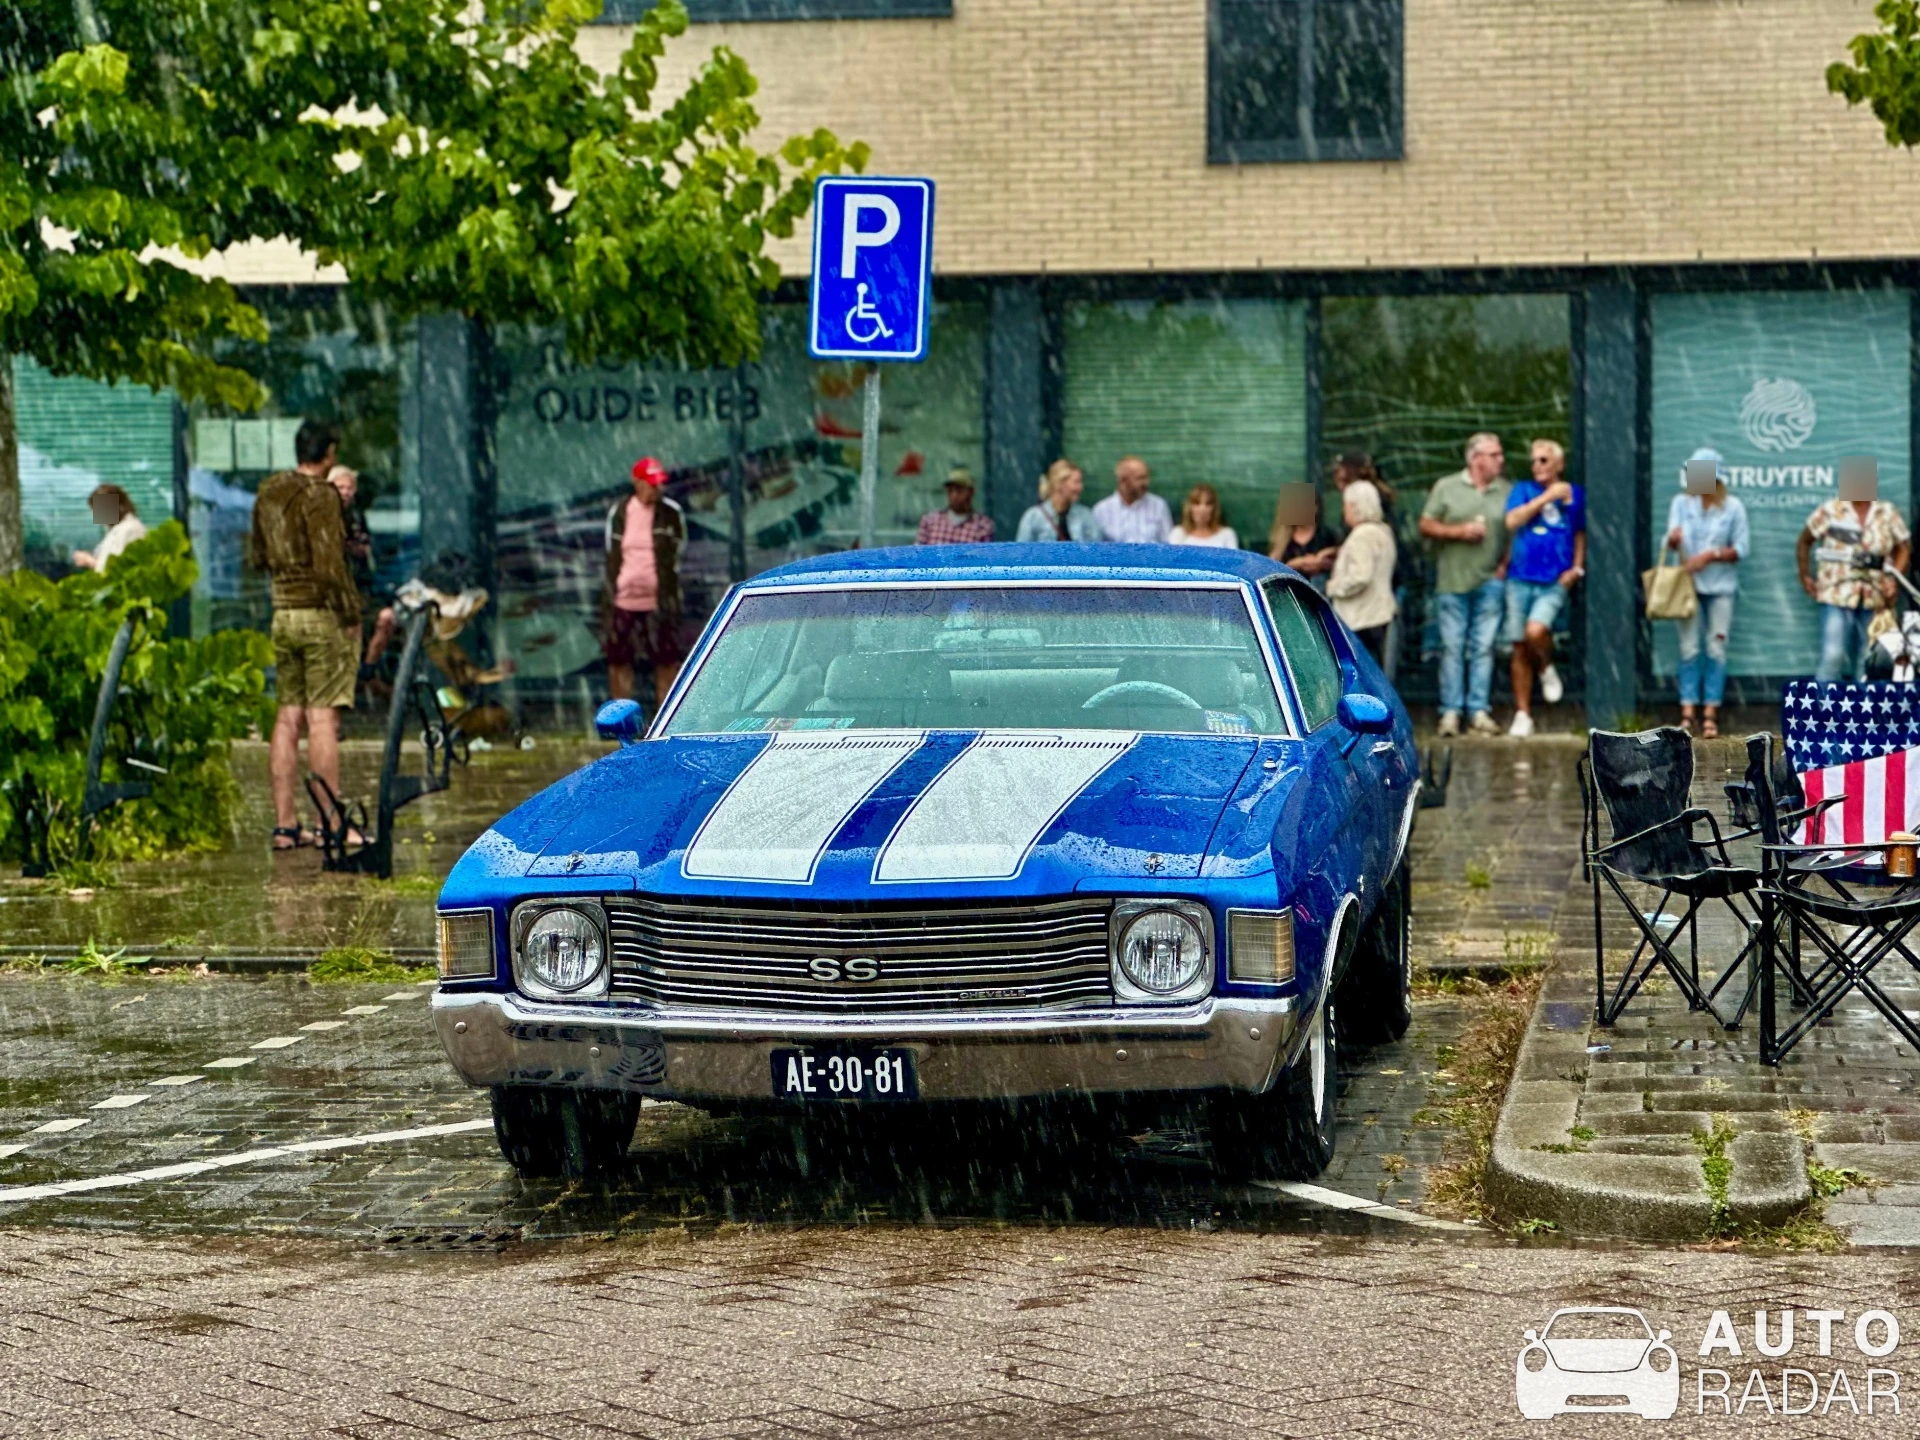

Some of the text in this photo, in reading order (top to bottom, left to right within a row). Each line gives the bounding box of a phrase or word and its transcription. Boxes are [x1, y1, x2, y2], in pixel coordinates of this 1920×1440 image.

[841, 193, 900, 278] P
[534, 385, 761, 422] OUDE BIEB
[809, 957, 879, 981] SS
[959, 989, 1026, 999] CHEVELLE
[786, 1056, 904, 1092] AE-30-81
